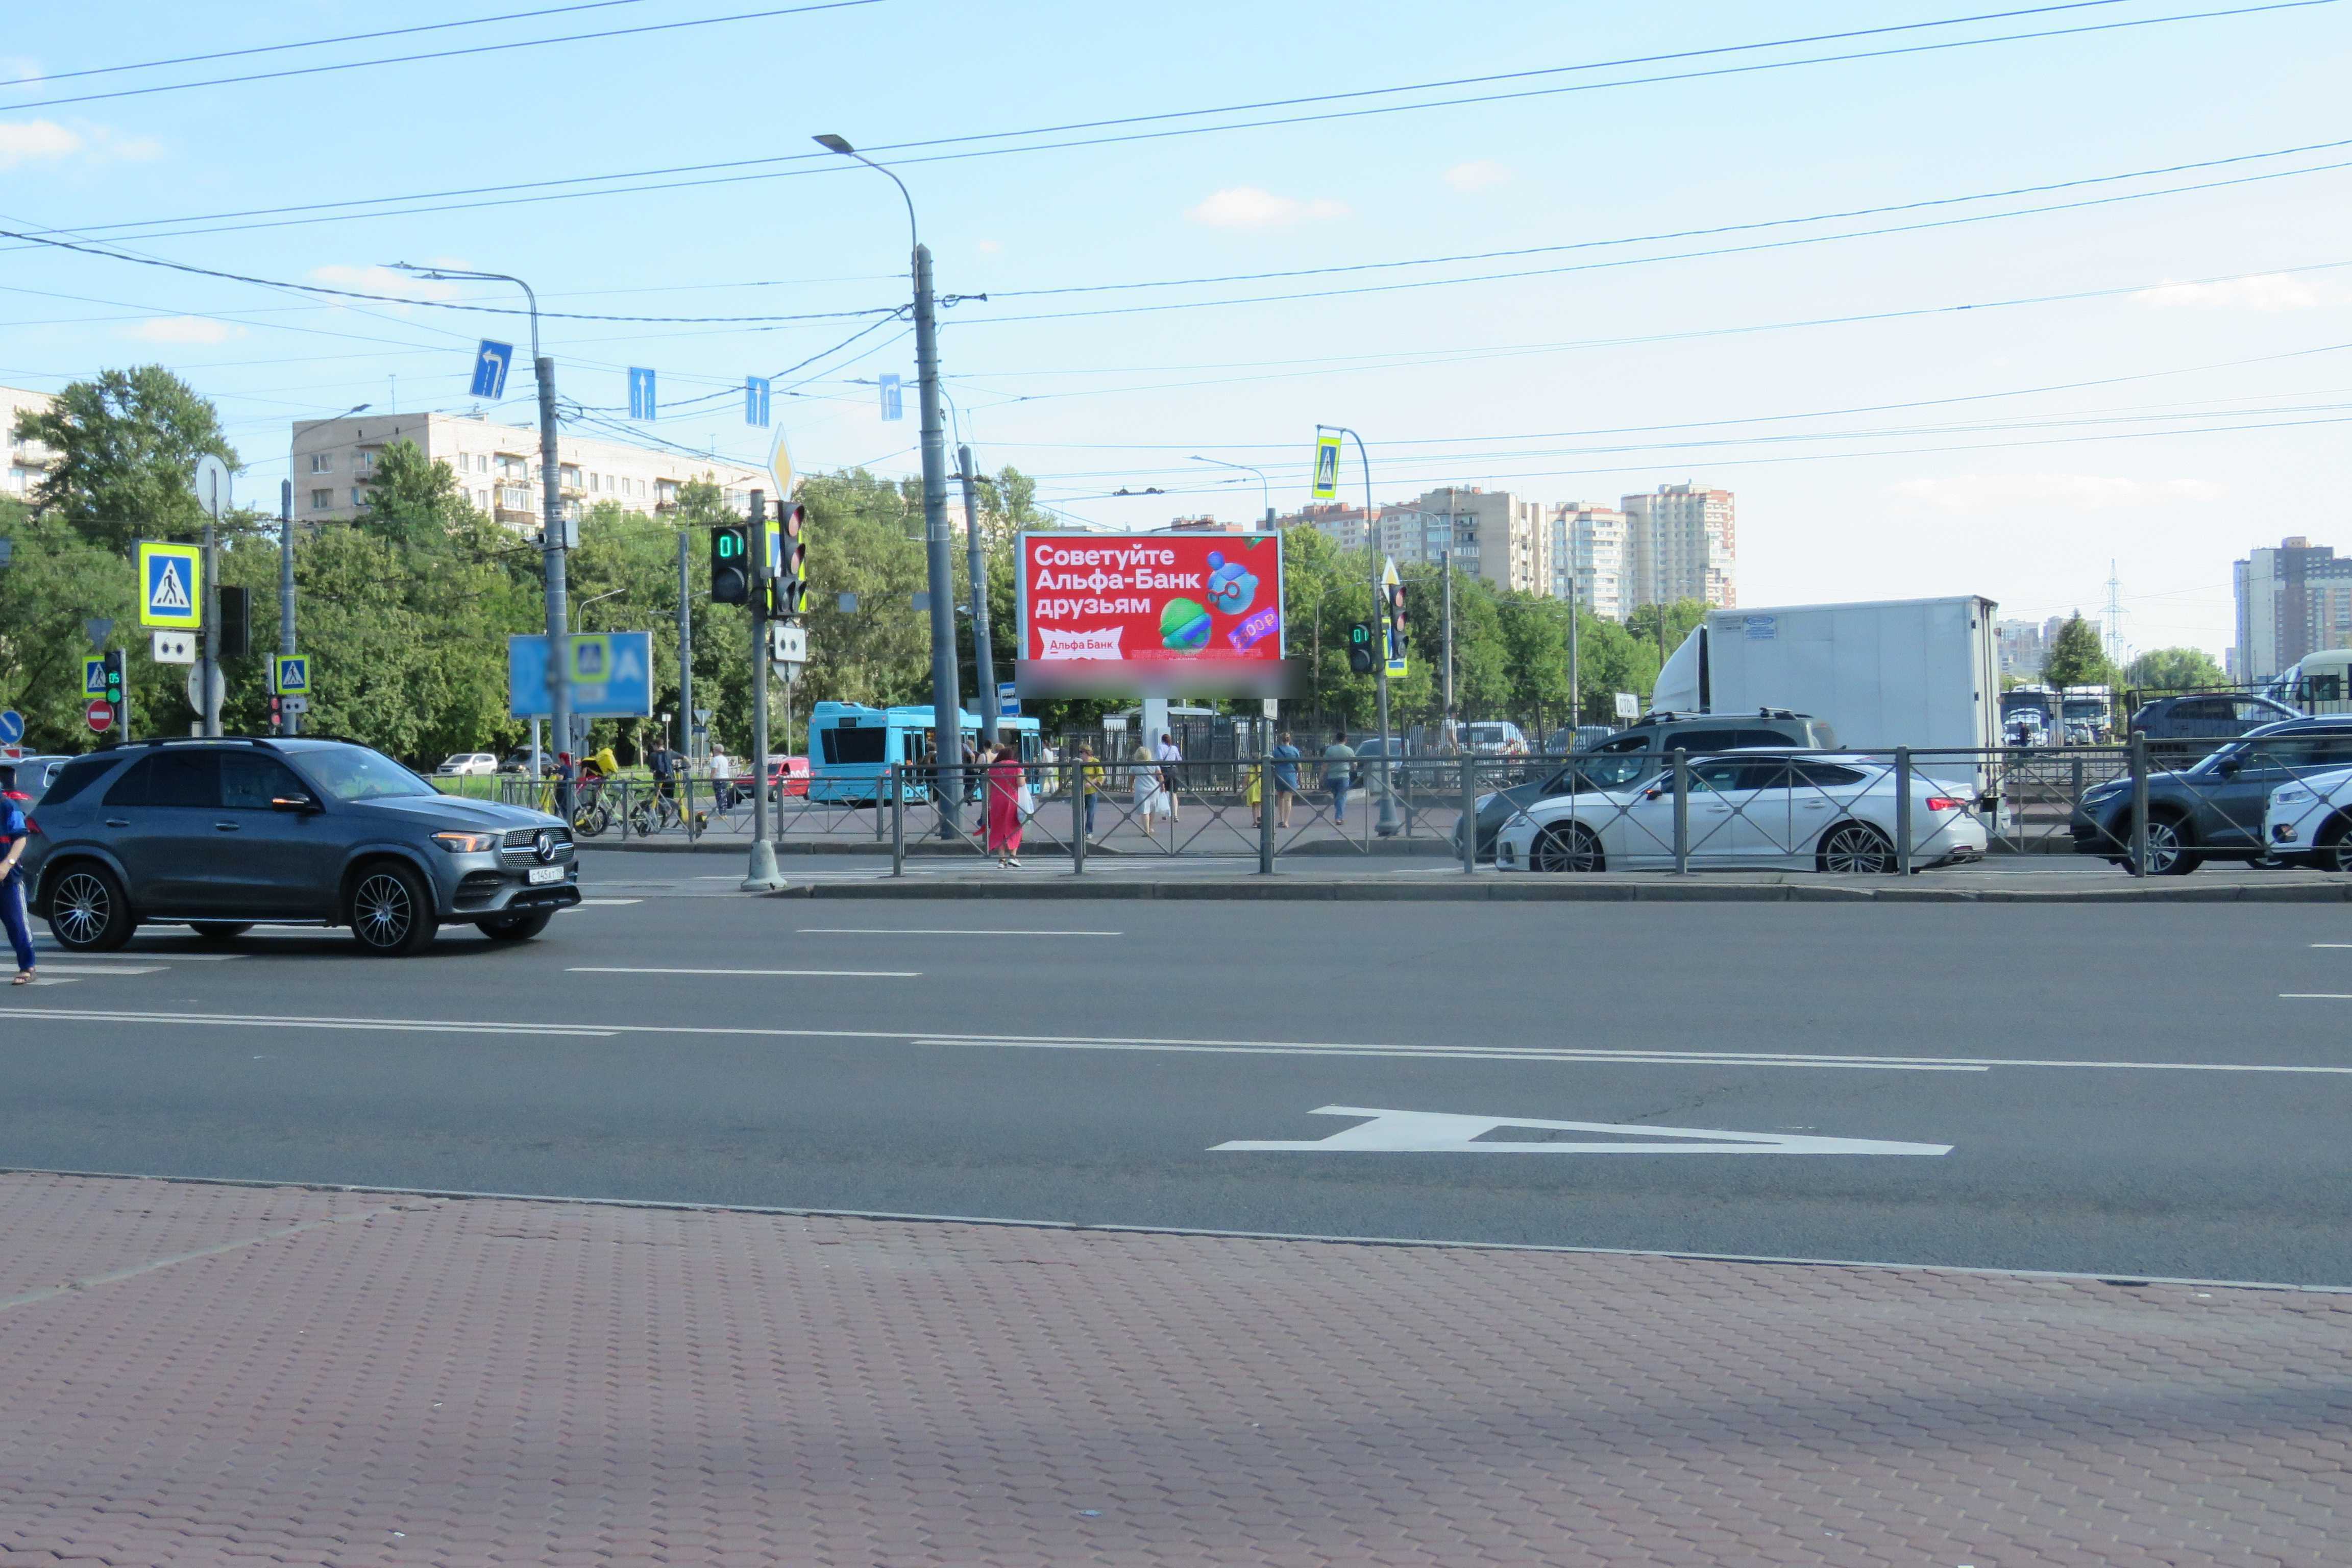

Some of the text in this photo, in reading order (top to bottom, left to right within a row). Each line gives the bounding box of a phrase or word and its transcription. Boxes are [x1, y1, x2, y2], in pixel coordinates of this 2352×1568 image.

[720, 536, 742, 557] 01
[1035, 544, 1174, 570] Советуйте
[1035, 568, 1201, 594] Альфа-Банк
[1035, 598, 1150, 619] друзьям
[1050, 639, 1114, 653] Альфа Банк
[1354, 629, 1367, 643] 01
